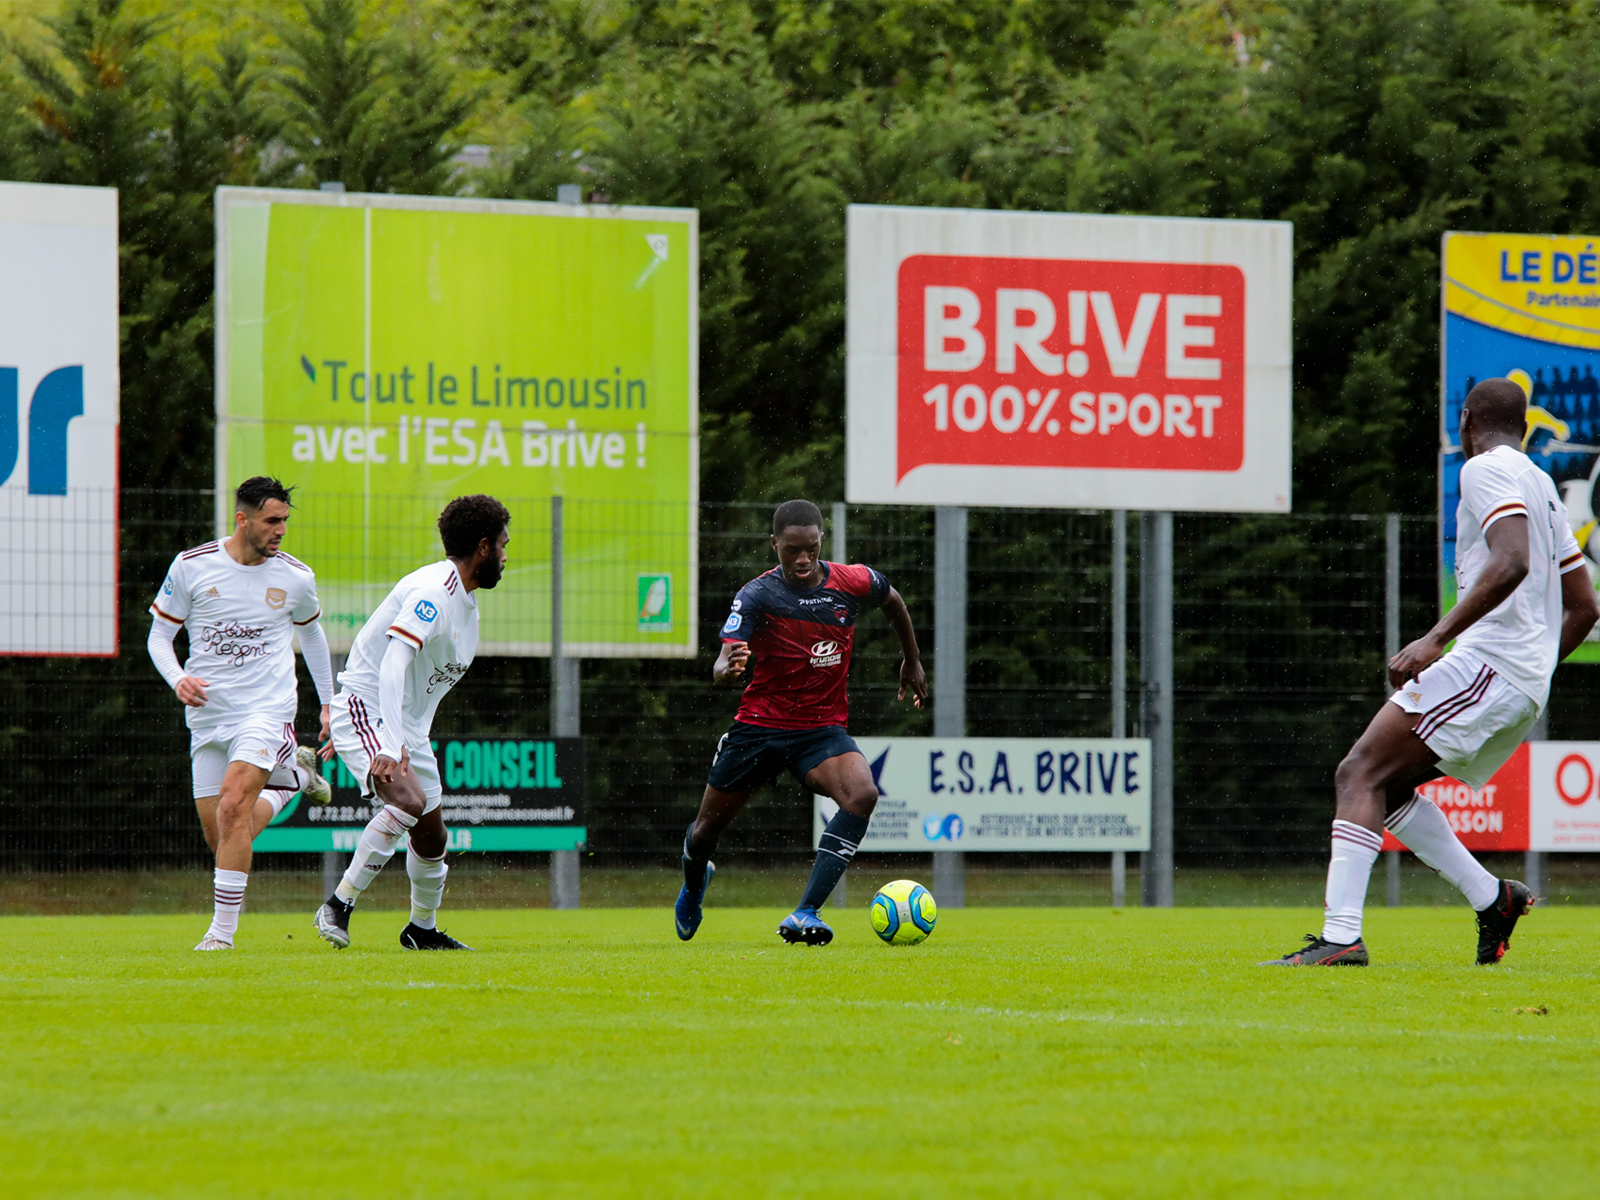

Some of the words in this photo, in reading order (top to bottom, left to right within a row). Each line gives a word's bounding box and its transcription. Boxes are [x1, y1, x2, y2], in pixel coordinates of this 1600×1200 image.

[1501, 251, 1541, 282] LE
[1553, 243, 1600, 284] DÉ
[322, 360, 414, 405] Tout
[427, 362, 458, 406] le
[471, 364, 647, 411] Limousin
[923, 383, 1061, 437] 100%
[1069, 390, 1222, 439] SPORT
[292, 424, 387, 465] avec
[399, 414, 511, 467] l'ESA
[522, 419, 626, 469] Brive
[417, 601, 436, 619] N3
[445, 741, 562, 789] CONSEIL
[929, 750, 1024, 795] E.S.A.
[1036, 750, 1142, 795] BRIVE
[1446, 810, 1503, 833] SSON
